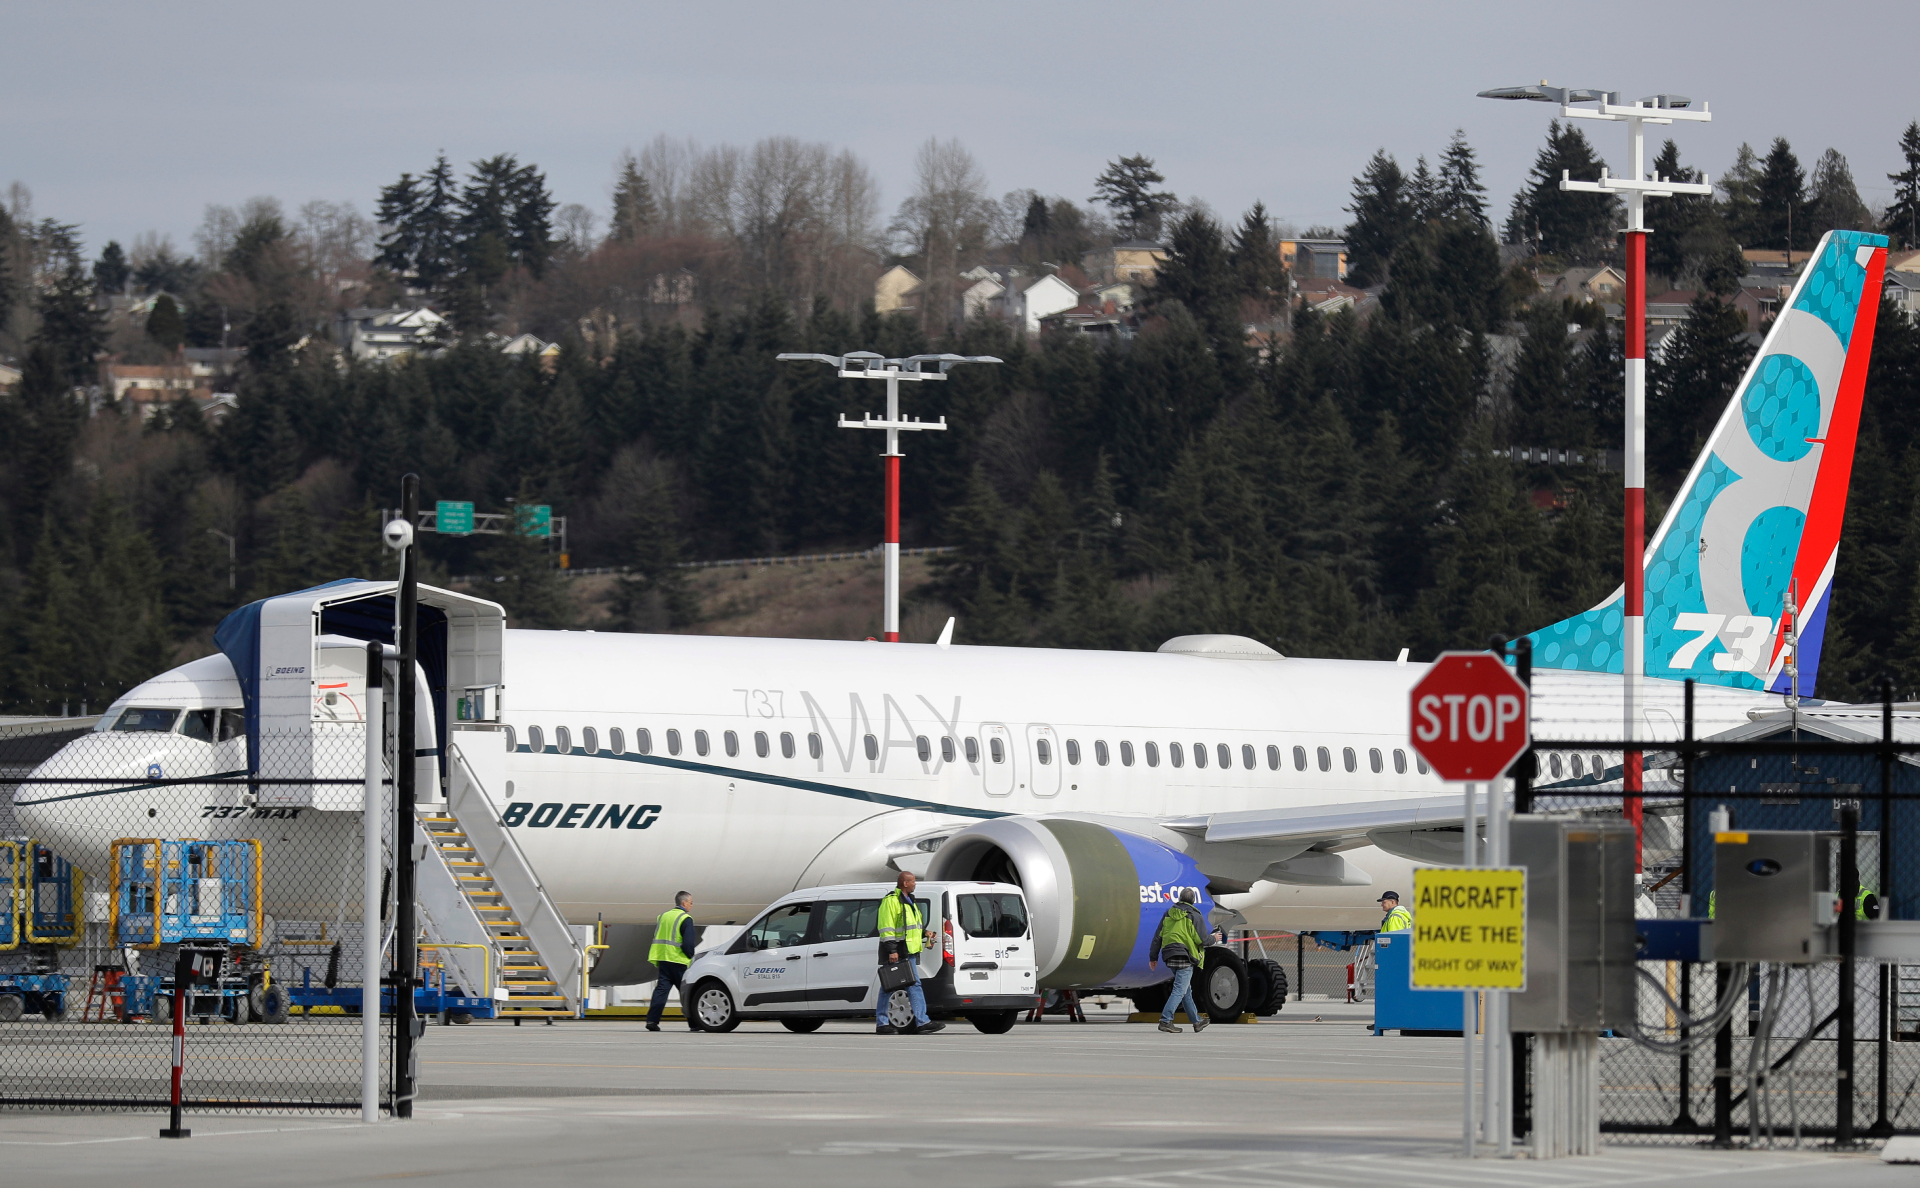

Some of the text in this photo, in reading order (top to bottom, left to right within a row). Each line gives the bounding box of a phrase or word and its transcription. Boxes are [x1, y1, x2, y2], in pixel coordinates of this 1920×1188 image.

[1416, 694, 1520, 742] STOP
[733, 689, 981, 776] 737 MAX
[201, 806, 301, 819] 737 MAX
[500, 803, 662, 829] BOEING
[1420, 886, 1518, 909] AIRCRAFT
[1419, 926, 1519, 943] HAVE THE
[995, 949, 1009, 959] B15
[1418, 958, 1518, 972] RIGHT OF WAY
